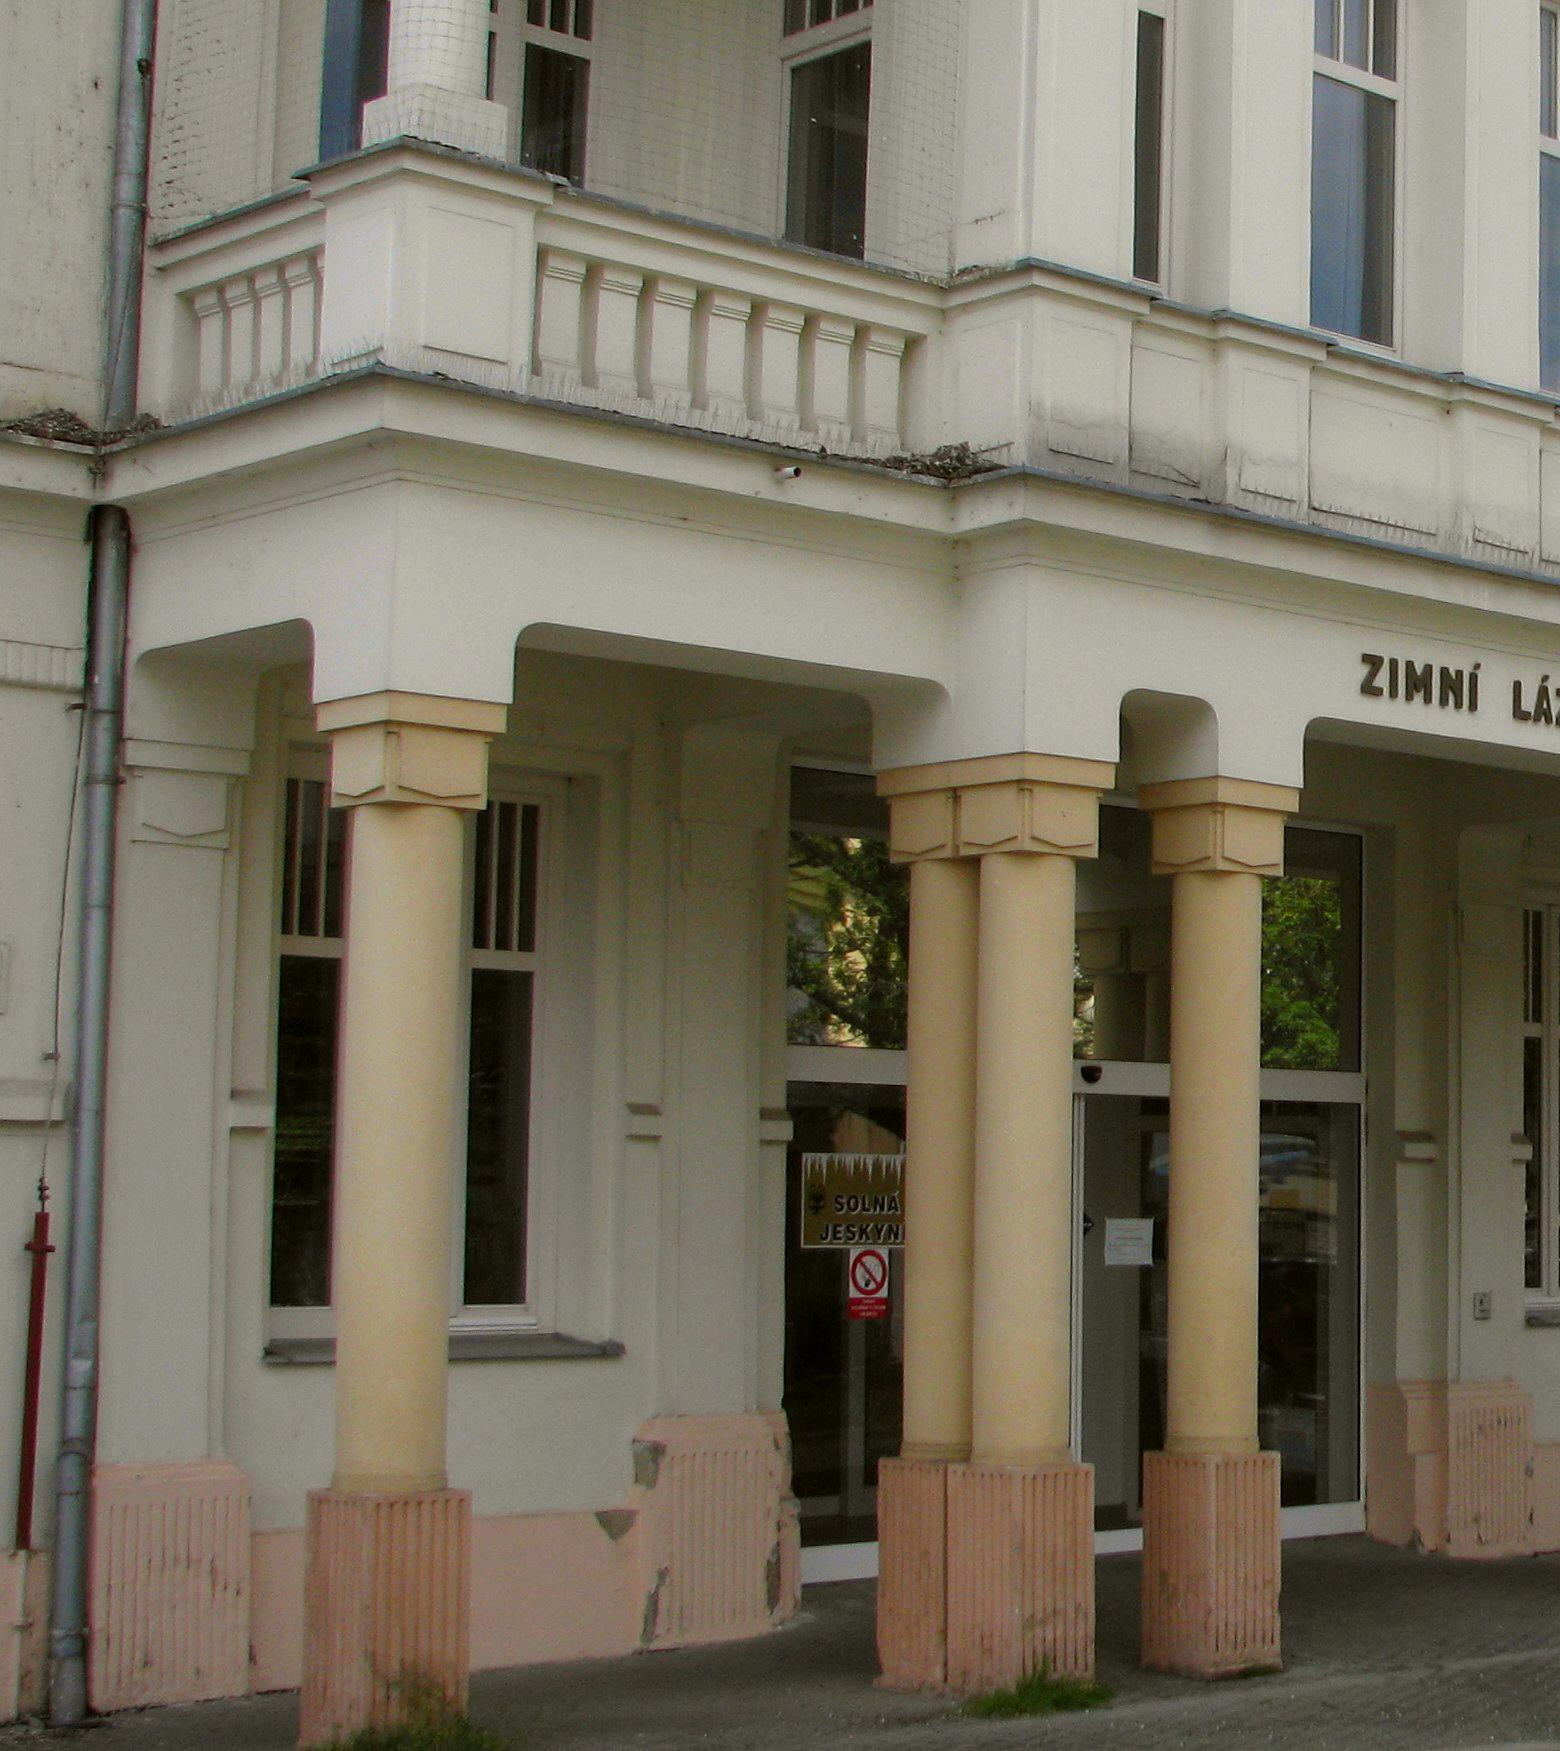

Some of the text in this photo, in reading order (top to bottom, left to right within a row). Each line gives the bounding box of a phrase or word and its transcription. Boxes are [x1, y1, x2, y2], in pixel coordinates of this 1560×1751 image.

[1360, 653, 1481, 712] ZIMNÍ
[834, 1192, 900, 1215] SOLNÁ
[820, 1223, 903, 1244] JESKYN
